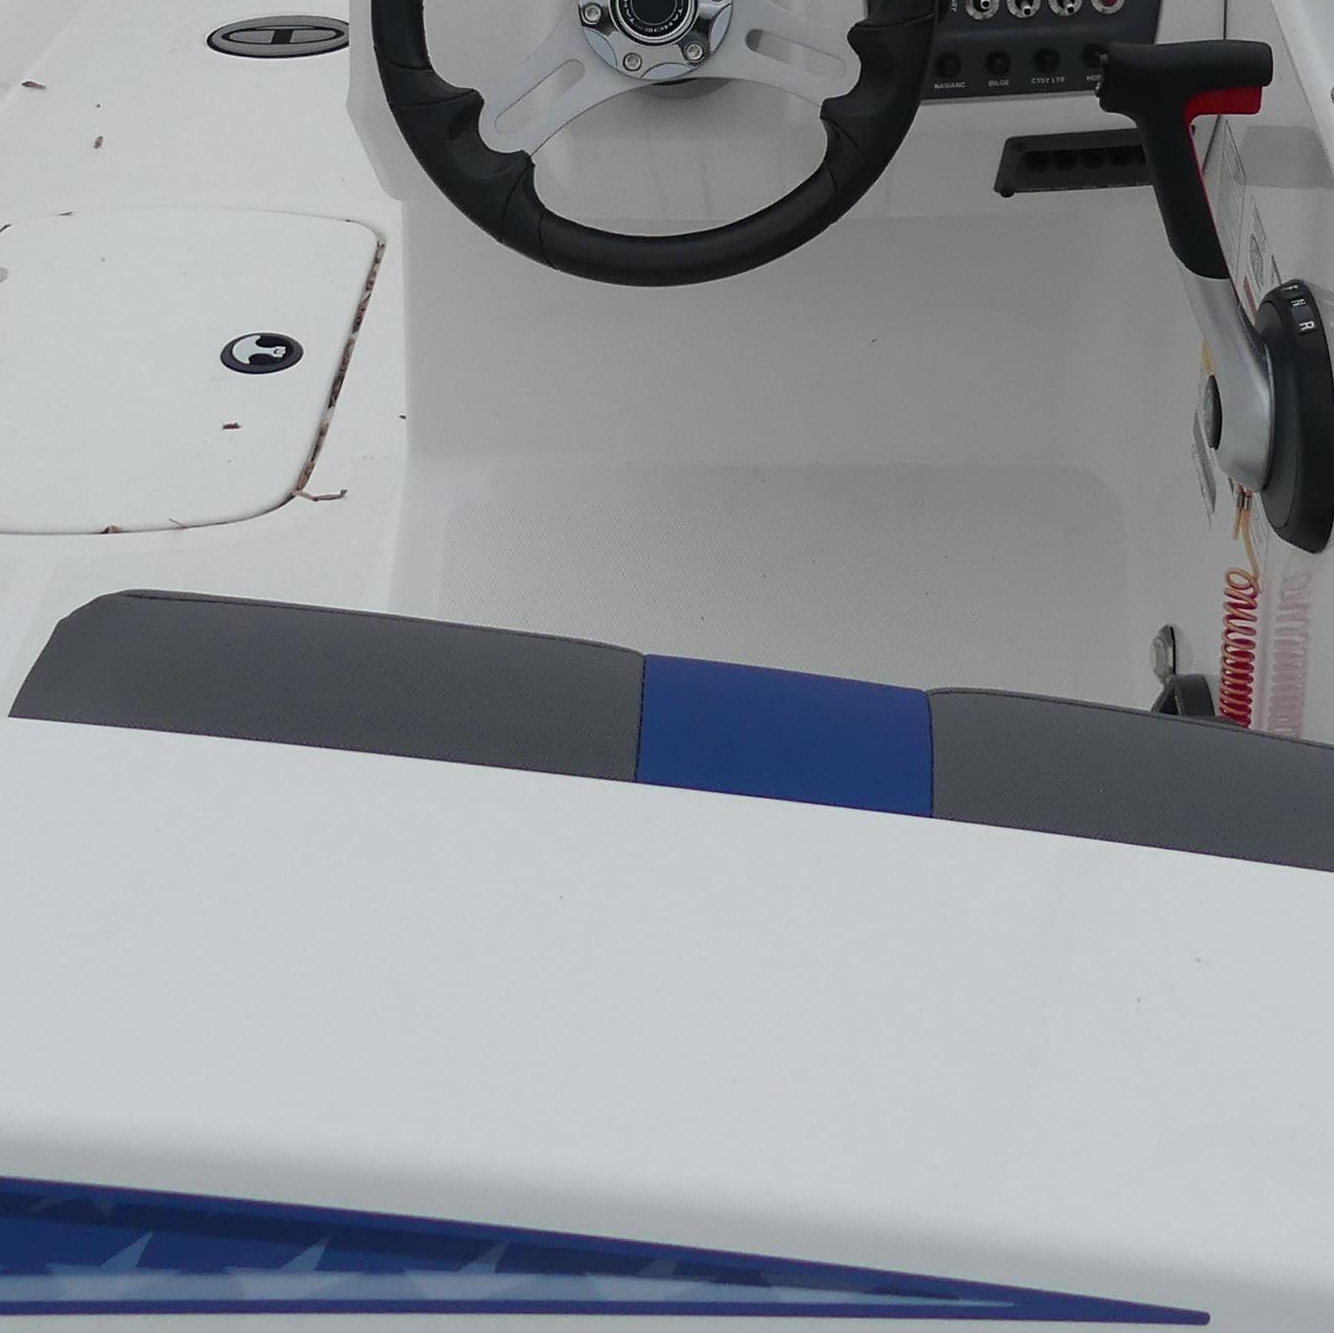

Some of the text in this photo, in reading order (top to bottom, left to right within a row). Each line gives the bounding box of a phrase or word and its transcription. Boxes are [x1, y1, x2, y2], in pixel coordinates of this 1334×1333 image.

[988, 79, 1009, 87] BILGE
[1031, 76, 1066, 85] CTSY LTS
[1299, 320, 1315, 332] R
